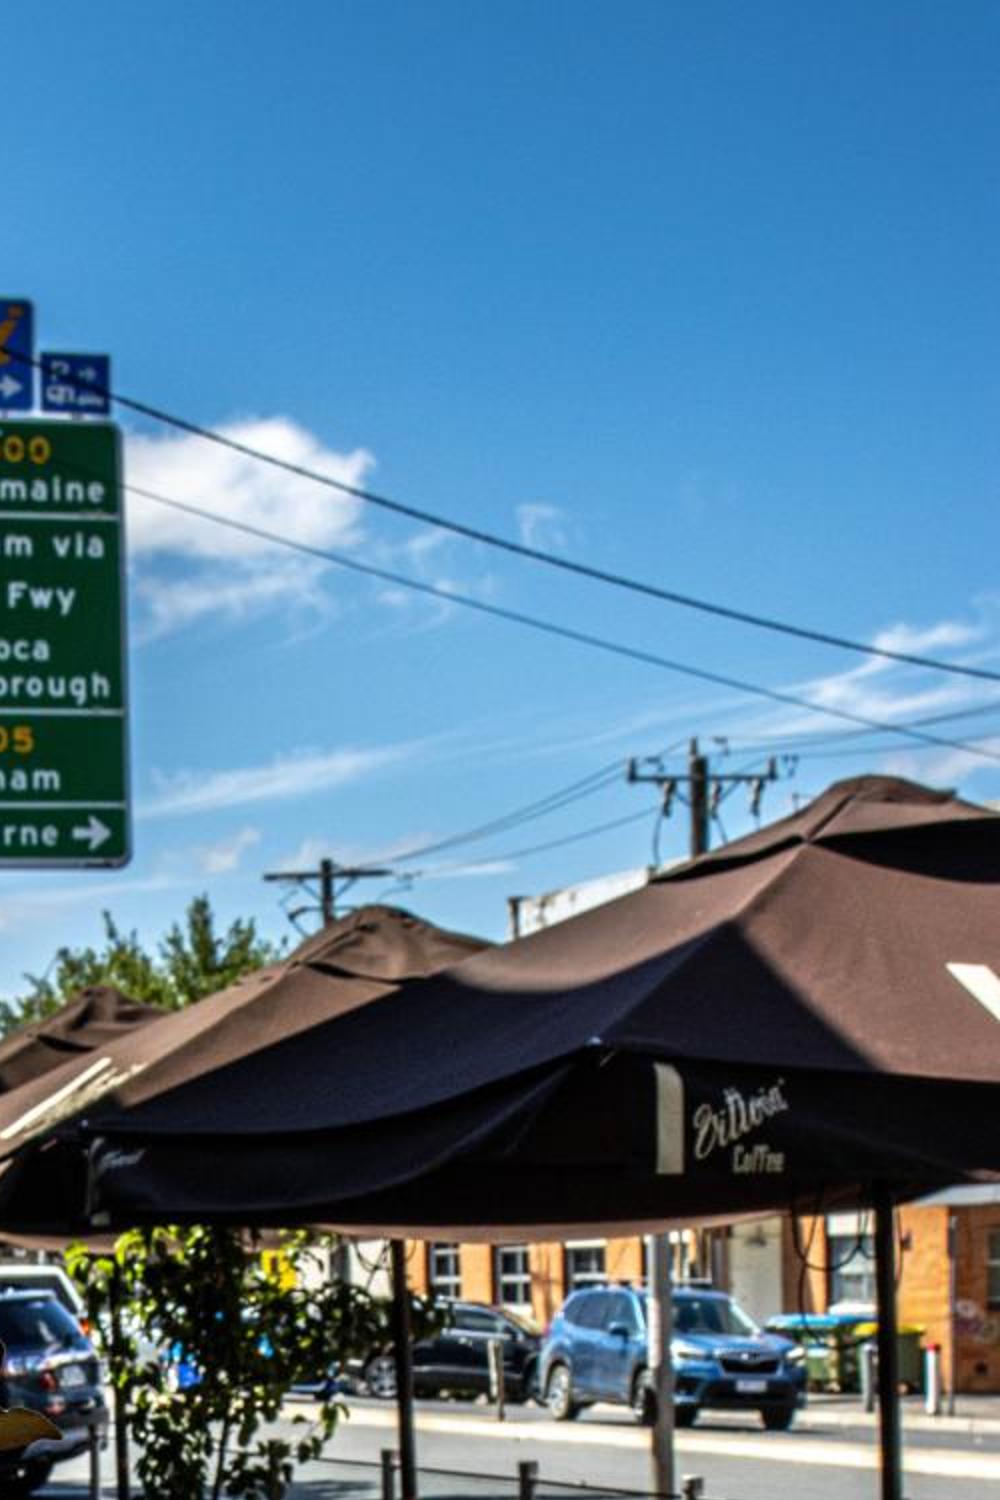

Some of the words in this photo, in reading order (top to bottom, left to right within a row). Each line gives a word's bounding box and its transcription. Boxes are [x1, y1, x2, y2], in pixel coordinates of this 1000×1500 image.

[53, 531, 105, 558] via
[7, 580, 77, 616] Fwy
[733, 1144, 785, 1173] Coffee
